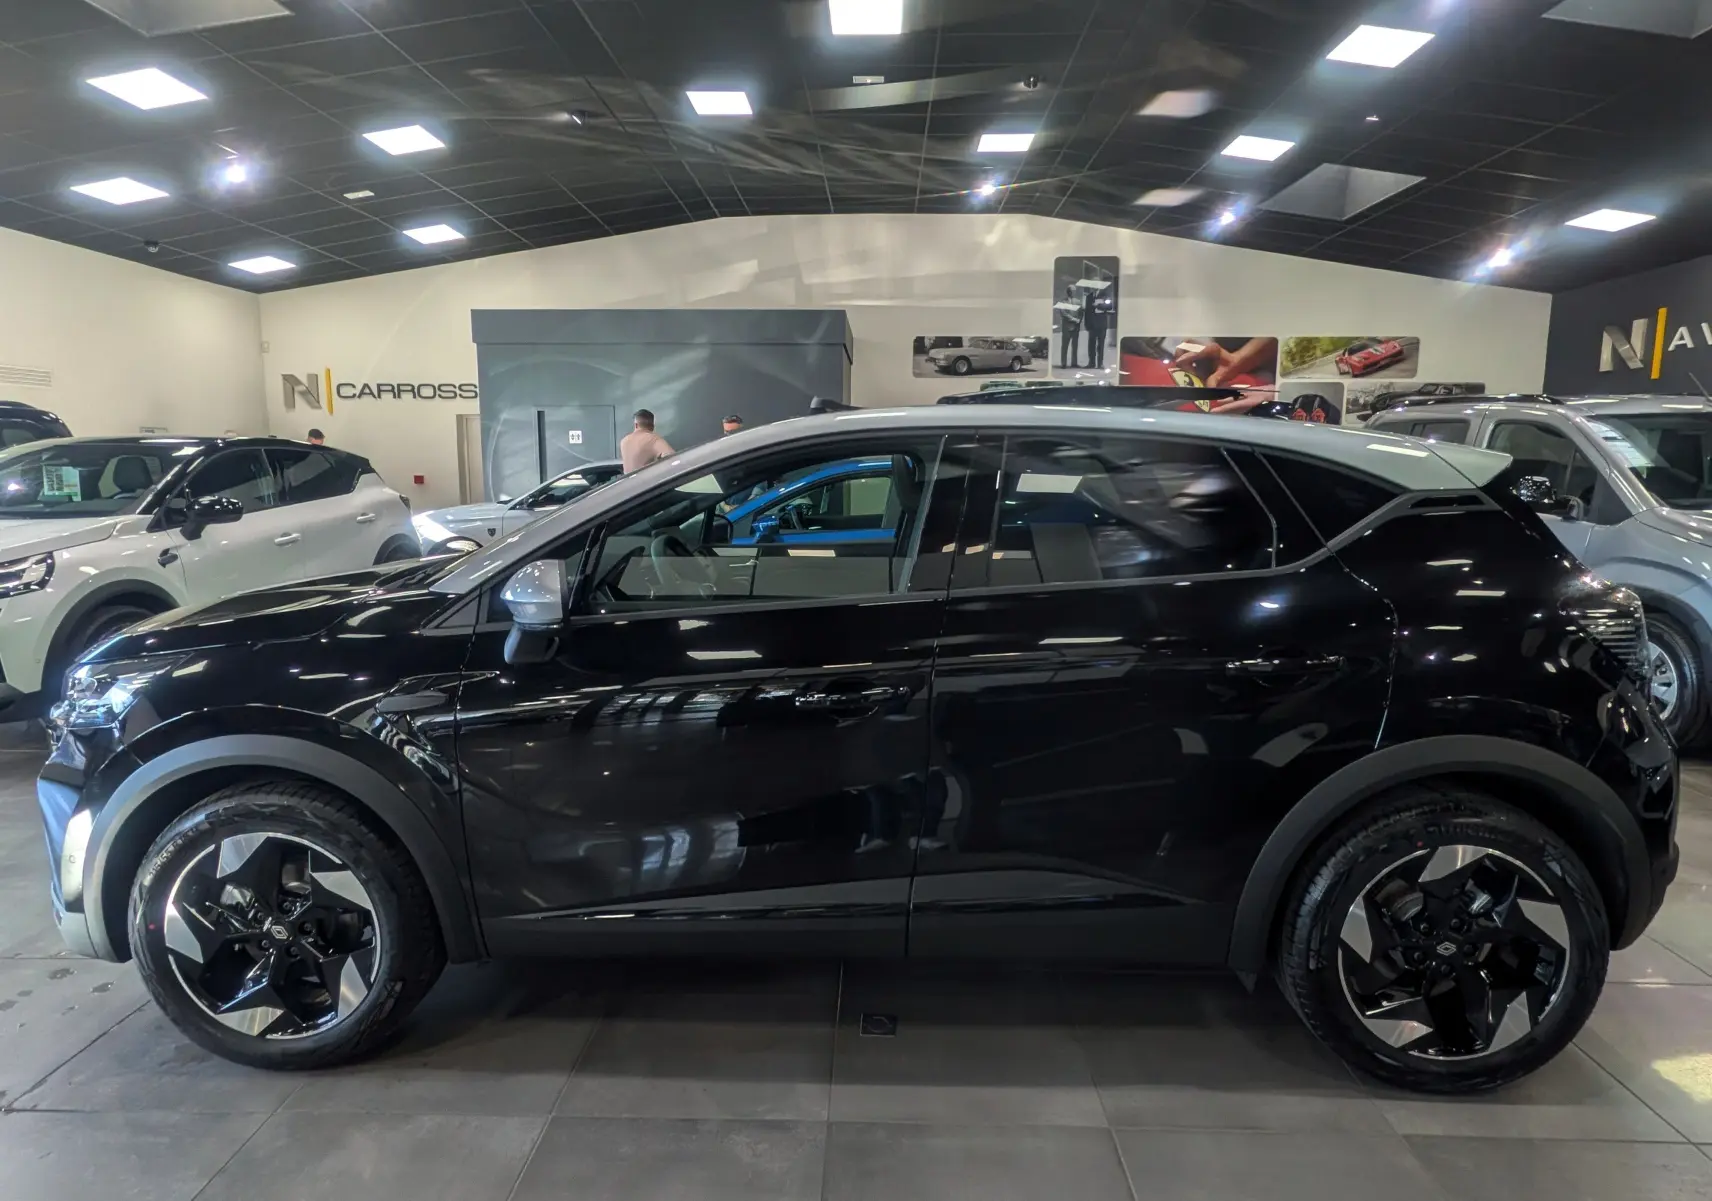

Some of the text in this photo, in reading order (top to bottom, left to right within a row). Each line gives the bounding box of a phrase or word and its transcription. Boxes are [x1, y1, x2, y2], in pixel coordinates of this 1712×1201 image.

[1599, 318, 1648, 372] N
[282, 373, 478, 410] N CARROSS
